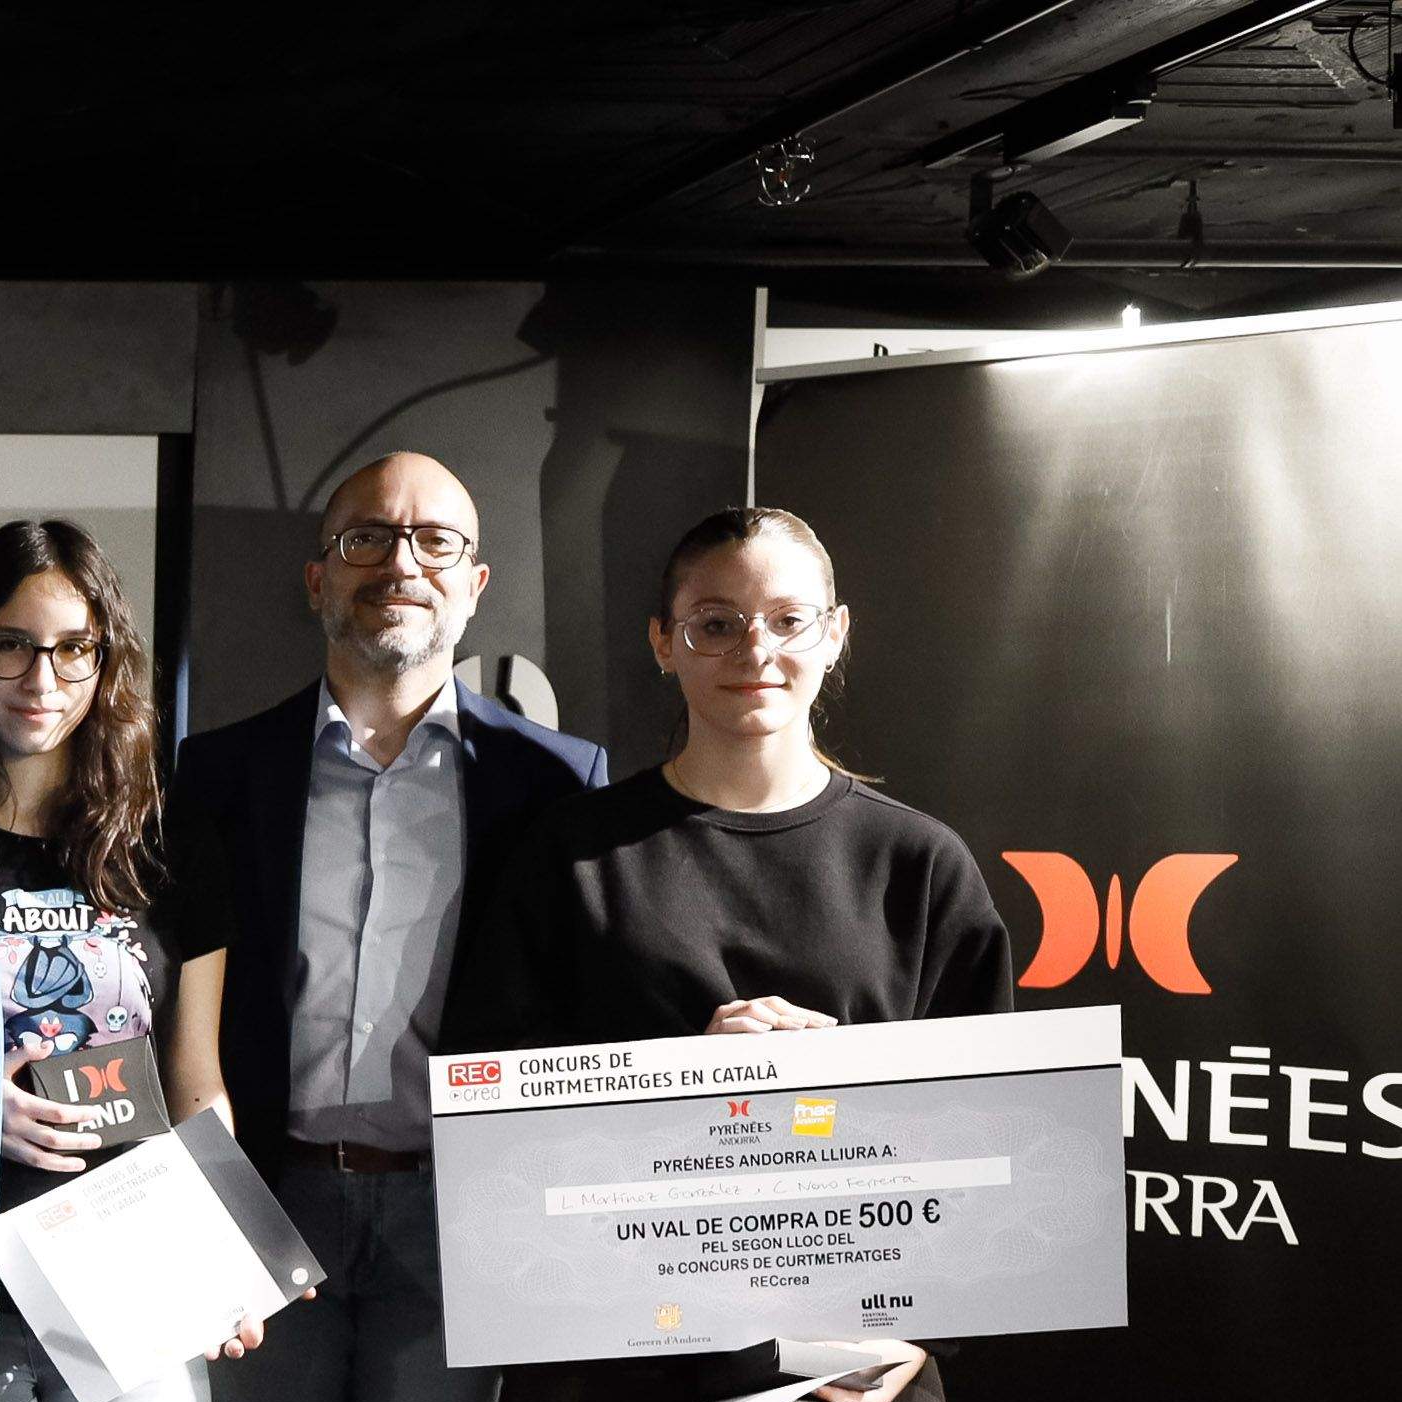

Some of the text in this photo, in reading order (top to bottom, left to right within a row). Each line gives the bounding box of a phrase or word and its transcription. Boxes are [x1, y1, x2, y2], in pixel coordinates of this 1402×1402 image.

[2, 904, 94, 932] ABOUT
[451, 1063, 501, 1085] REC
[519, 1052, 633, 1075] CONCURS DE
[520, 1060, 779, 1098] CURTMETRATGES EN CATALÀ
[463, 1086, 501, 1101] crea
[794, 1104, 836, 1118] fnac
[718, 1135, 762, 1146] ANDORRA
[653, 1144, 898, 1174] PYRÉNÉES ANDORRA LLIURA A:
[1126, 1169, 1300, 1246] RRA
[617, 1198, 941, 1240] UN VAL DE COMPRA DE 500 €
[702, 1232, 855, 1253] PEL SEGON LLOC DEL
[658, 1248, 901, 1275] 9è CONCURS DE CURTMETRATGES
[750, 1275, 810, 1288] RECcrea
[861, 1294, 914, 1310] ull nu
[627, 1334, 712, 1347] Govern d'Andorra
